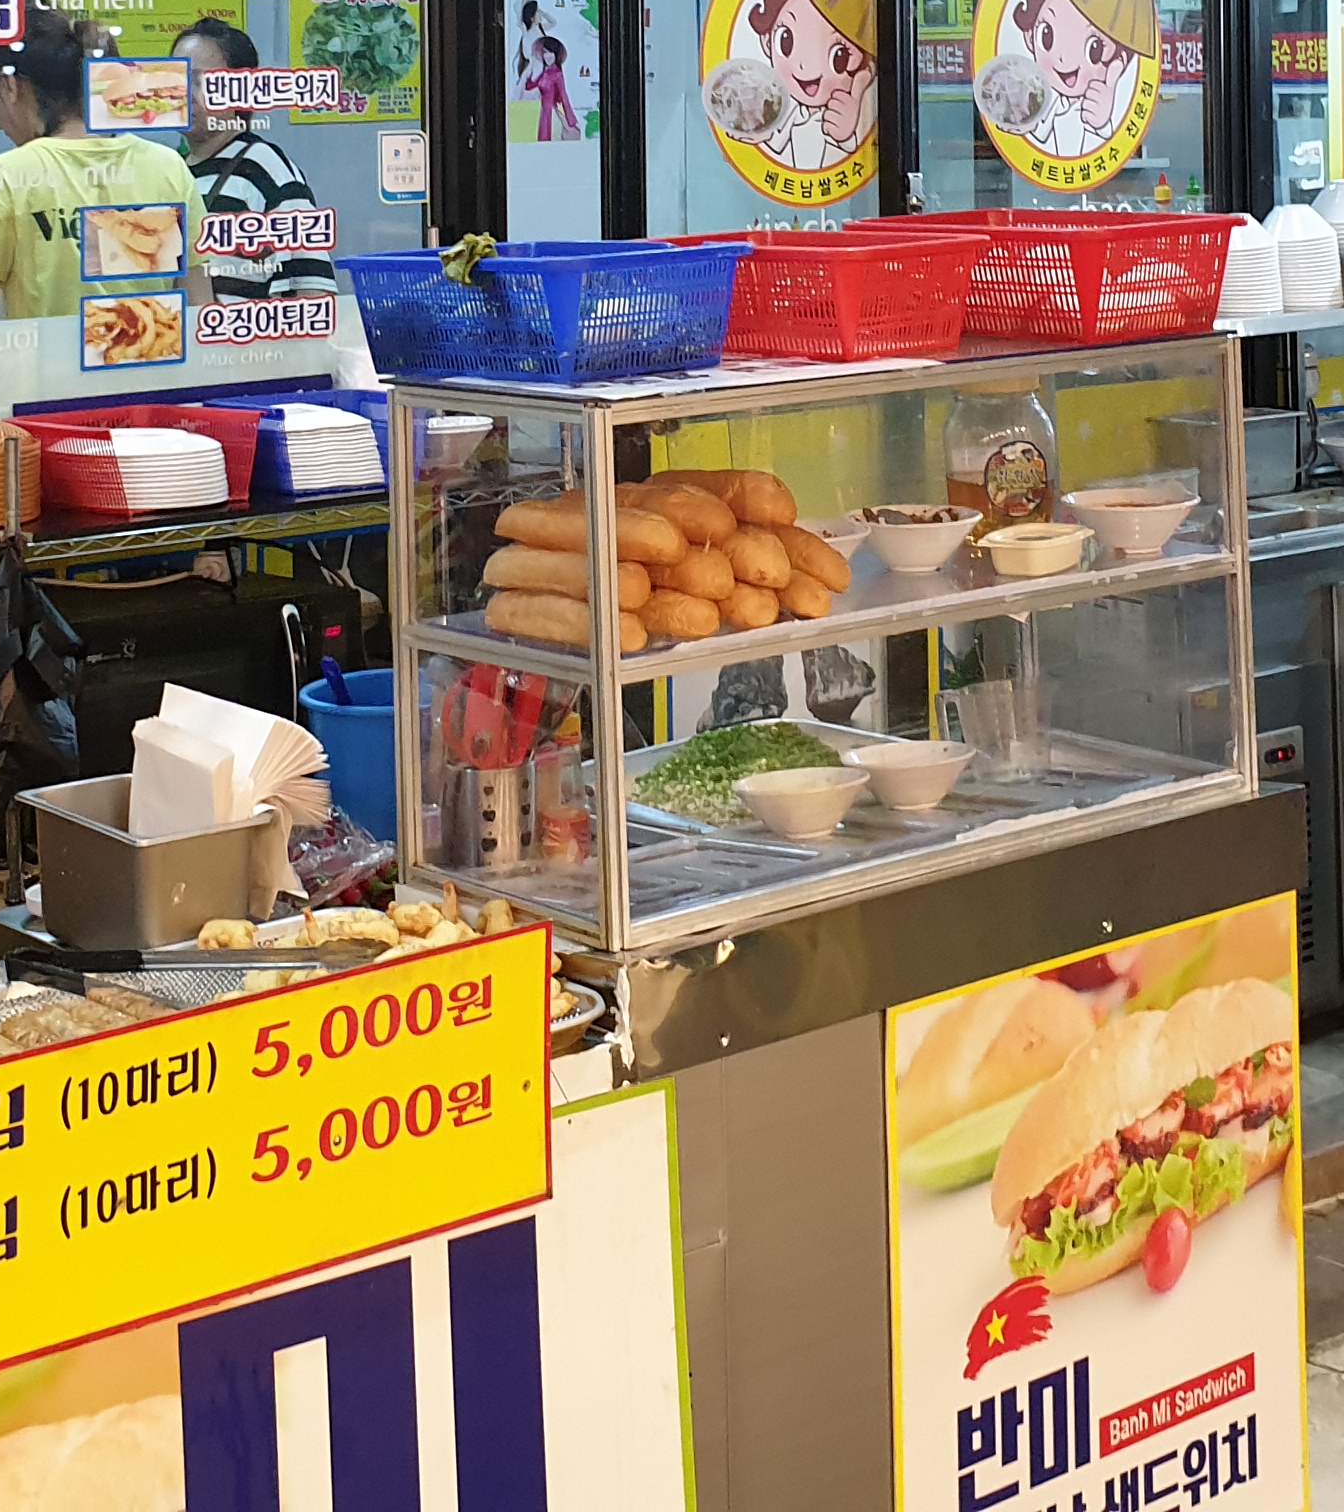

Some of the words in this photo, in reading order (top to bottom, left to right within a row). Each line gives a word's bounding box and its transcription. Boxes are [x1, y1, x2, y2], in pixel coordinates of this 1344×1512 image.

[205, 69, 339, 107] 반미샌드위치
[764, 159, 865, 198] 베트남쌀국수
[1030, 146, 1121, 185] 베트남쌀국수
[199, 211, 334, 249] 새우튀김
[200, 300, 332, 340] 오징어튀김
[58, 1039, 219, 1135] (10마리)
[250, 973, 495, 1080] 5,000원
[58, 1146, 219, 1242] (10마리)
[250, 1074, 495, 1184] 5,000원
[1109, 1413, 1149, 1446] Banh
[1152, 1400, 1171, 1428] Mi
[1175, 1364, 1247, 1413] Sandwich
[956, 1355, 1091, 1512] 반미
